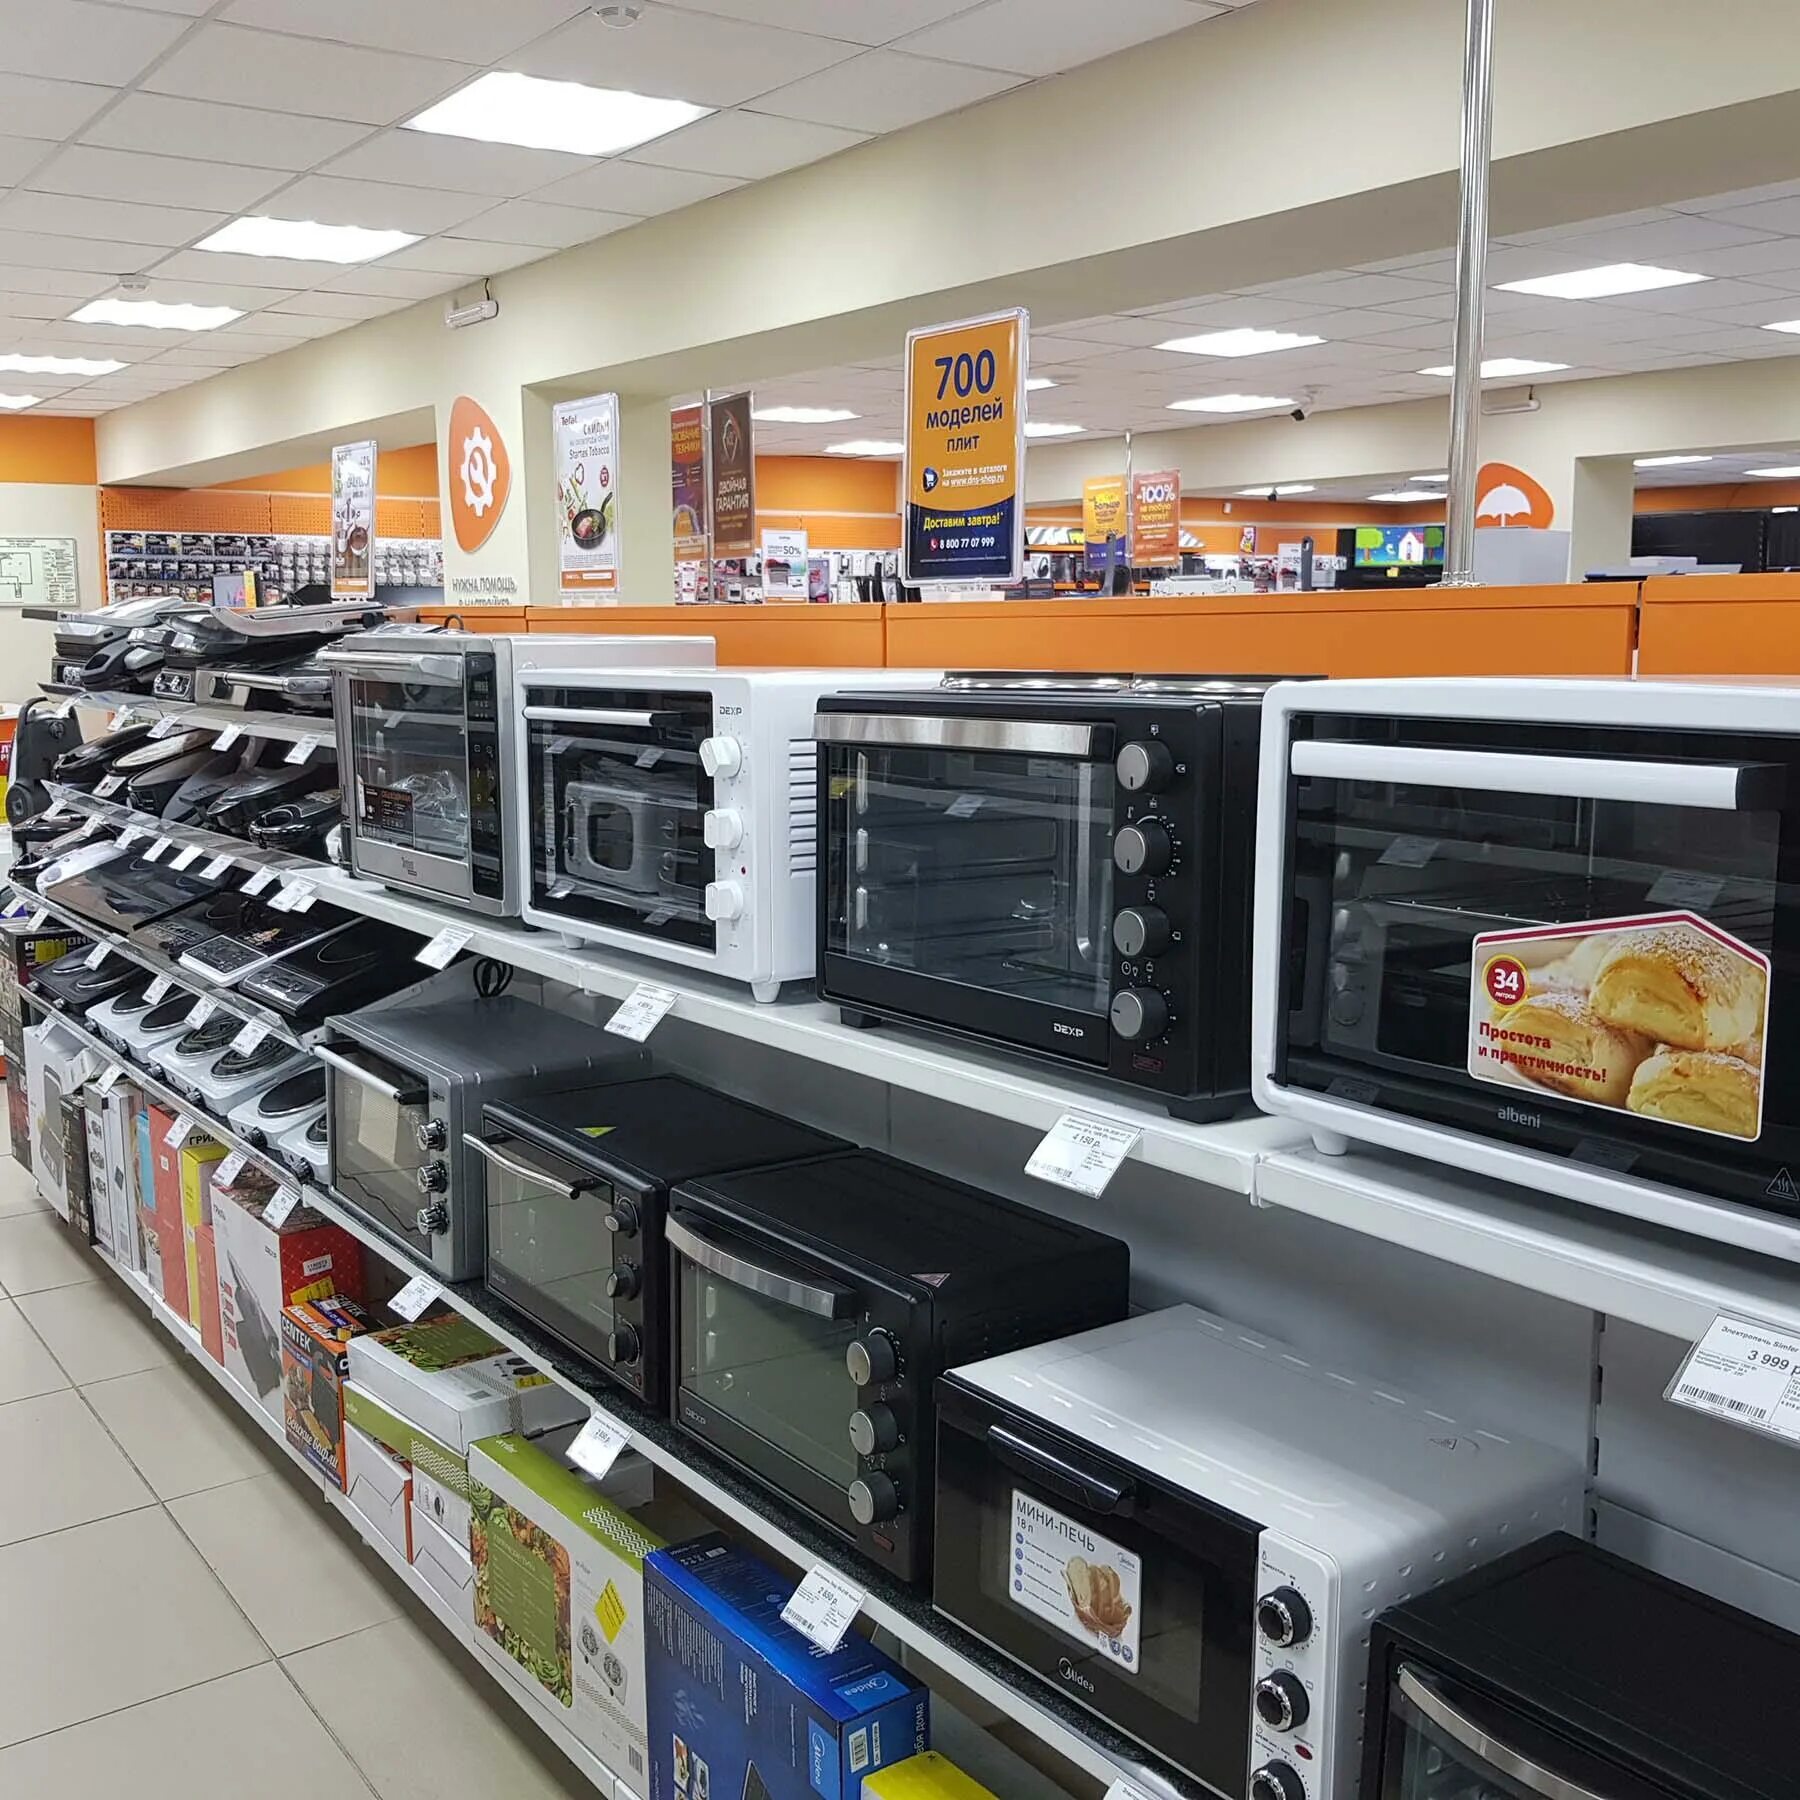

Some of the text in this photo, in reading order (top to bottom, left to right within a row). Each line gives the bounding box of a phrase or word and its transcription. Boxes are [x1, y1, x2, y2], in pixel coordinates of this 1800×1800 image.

[935, 349, 995, 400] 700
[561, 415, 577, 426] Tefal
[926, 397, 1003, 430] моделей
[946, 435, 980, 453] плит
[719, 476, 748, 496] ДВОЙНАЯ
[1136, 483, 1176, 504] -100%
[715, 493, 750, 513] ГАРАНТИЯ
[923, 516, 966, 531] Доставим
[783, 545, 801, 555] 50%
[939, 537, 995, 549] 8 800 77 07 999
[452, 578, 479, 593] НУЖНА
[720, 706, 742, 716] DEXP
[1493, 968, 1519, 991] 34
[1495, 991, 1516, 1000] литров
[1053, 1022, 1084, 1038] DEXP
[1479, 1022, 1551, 1049] Простота
[1478, 1045, 1607, 1083] и практичность!
[1497, 1106, 1541, 1129] albeni
[1072, 1133, 1080, 1141] 4
[1079, 1135, 1095, 1145] 150
[281, 1315, 312, 1354] CENTEK
[1721, 1325, 1800, 1354] Электропечь Simfer
[1747, 1350, 1759, 1361] 3
[1760, 1353, 1790, 1371] 999
[1016, 1498, 1096, 1552] МИНИ-ПЕЧЬ
[1016, 1516, 1034, 1534] 18 л
[817, 1586, 825, 1594] 2
[1058, 1656, 1095, 1693] Midea
[843, 1676, 889, 1696] Midea
[915, 1701, 926, 1732] дома
[812, 1731, 826, 1786] Midea
